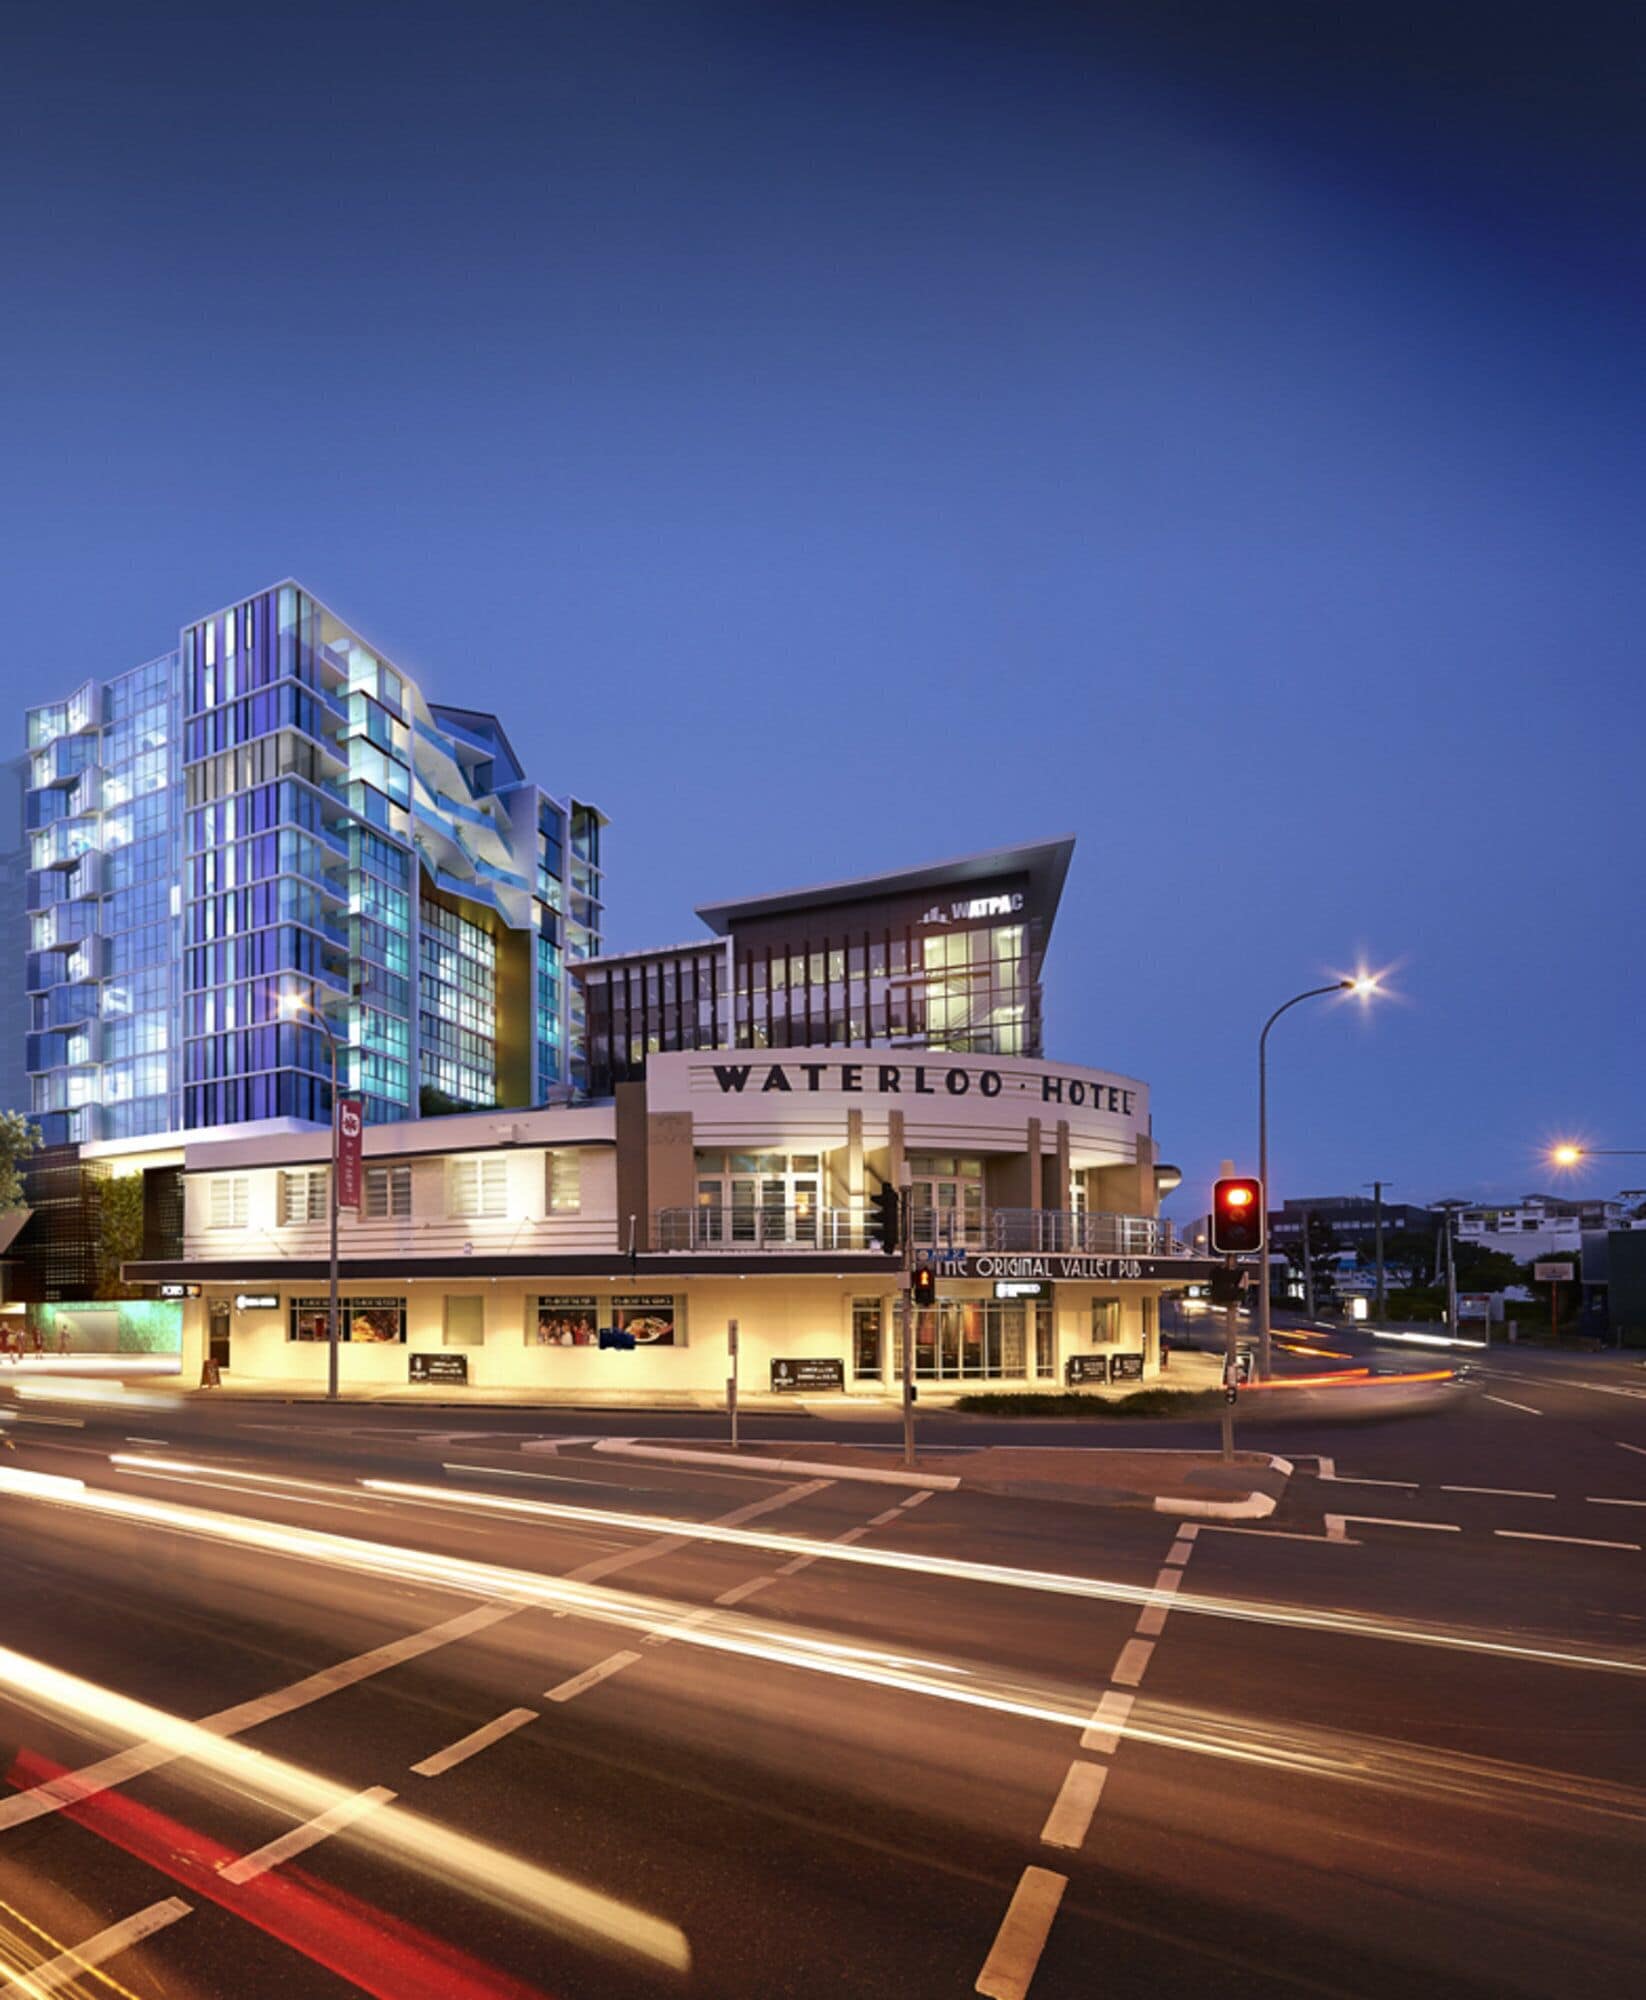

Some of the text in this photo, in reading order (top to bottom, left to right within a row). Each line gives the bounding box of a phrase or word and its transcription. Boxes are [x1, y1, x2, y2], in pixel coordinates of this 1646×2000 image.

[951, 893, 1024, 920] WATPAC
[713, 1063, 1132, 1116] WATERLOO HOTEL
[976, 1257, 1053, 1277] ORIGINAL
[1060, 1258, 1112, 1277] VALLEY
[1119, 1260, 1142, 1277] PUB
